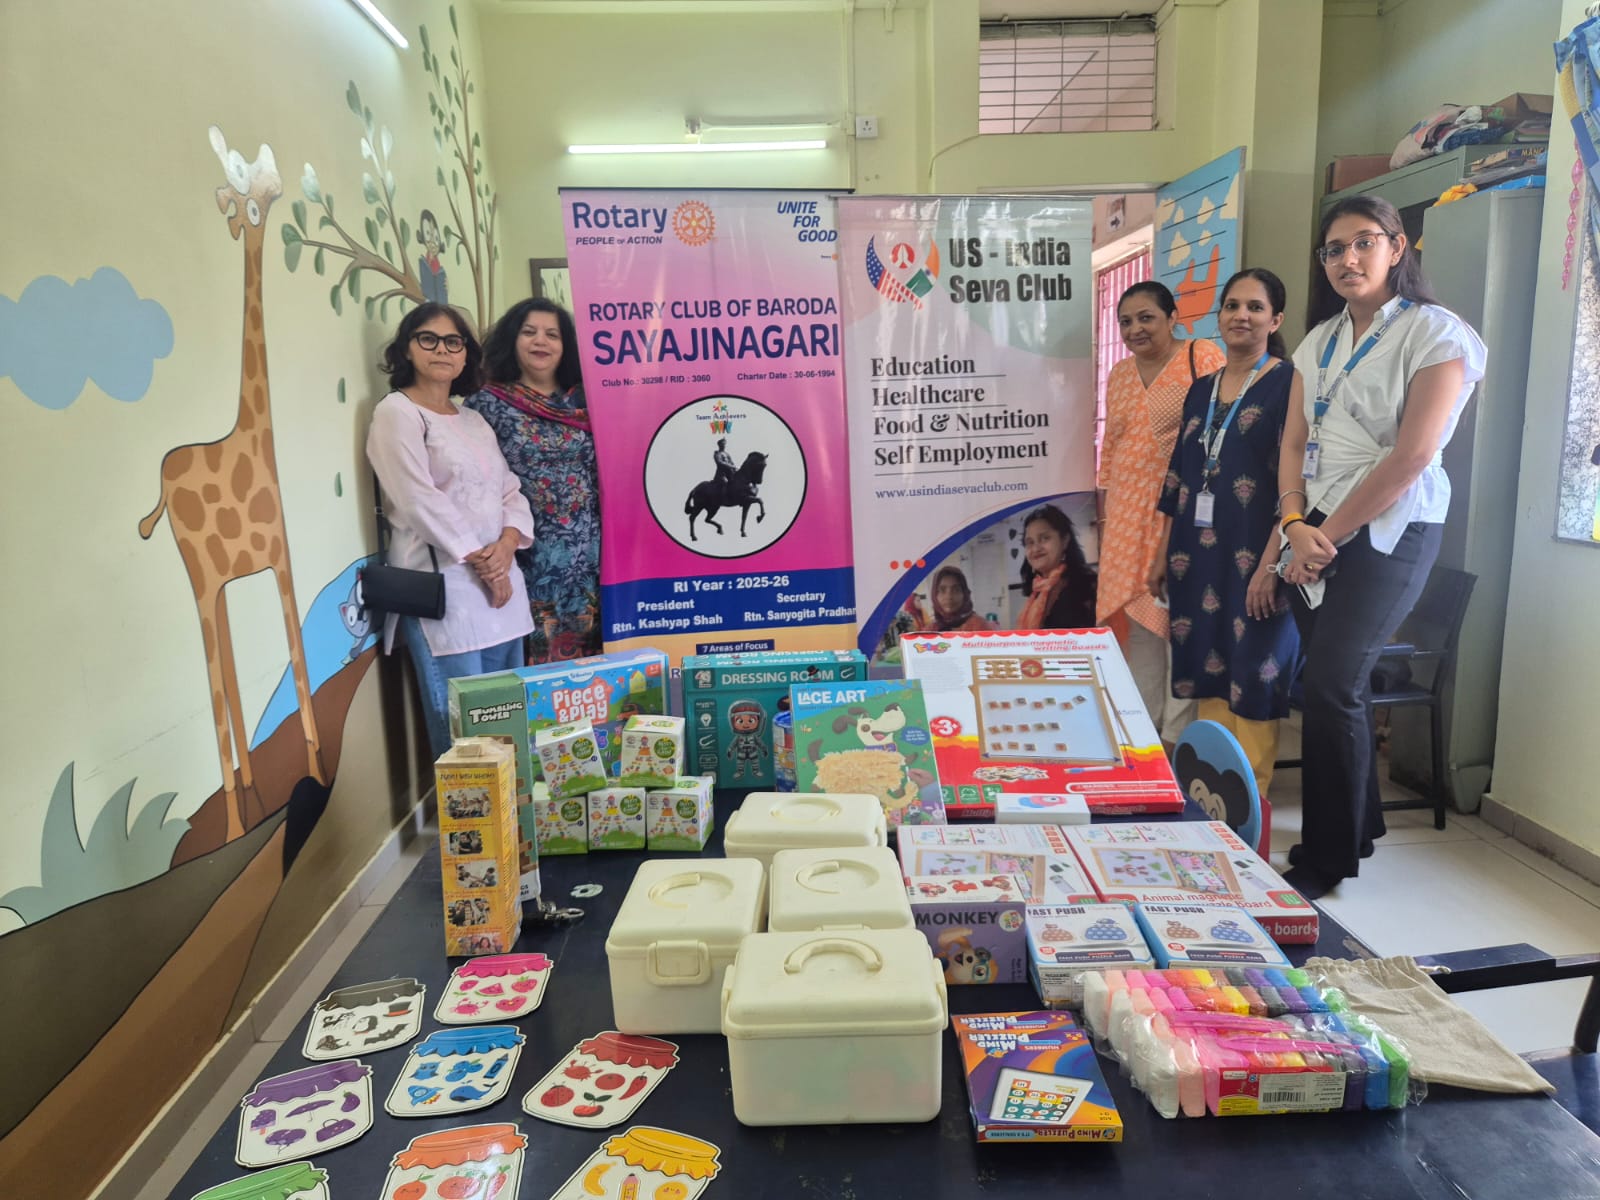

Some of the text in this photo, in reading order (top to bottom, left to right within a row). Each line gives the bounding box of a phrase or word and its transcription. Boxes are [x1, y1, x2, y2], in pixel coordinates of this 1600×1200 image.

[777, 201, 817, 214] UNITE
[572, 201, 668, 233] Rotary
[793, 215, 820, 228] FOR
[575, 237, 615, 245] PEOPLE
[626, 236, 663, 245] ACTION
[798, 229, 838, 242] GOOD
[949, 238, 982, 268] US
[1005, 237, 1071, 267] India
[950, 273, 1072, 304] Seva Club
[589, 297, 838, 321] ROTARY CLUB OF BARODA
[593, 323, 840, 366] SAYAJINAGARI
[871, 355, 975, 377] Education
[601, 379, 622, 387] Club
[670, 376, 685, 384] RID
[737, 372, 767, 381] Charter
[768, 371, 787, 380] Date
[872, 385, 985, 407] Healthcare
[874, 409, 1049, 435] Food & Nutrition
[874, 440, 1048, 466] Self Employment
[875, 480, 1028, 499] www.usindiasevaclub.com
[673, 581, 688, 593] RI
[692, 579, 724, 592] Year
[736, 575, 789, 589] 2025-26
[776, 591, 826, 603] Secretary
[636, 599, 695, 612] President
[744, 611, 765, 622] Rtn.
[767, 608, 816, 622] Sanyogita
[612, 614, 723, 634] Rtn. Kashyap Shah
[709, 644, 733, 653] Areas
[735, 643, 743, 651] of
[745, 642, 768, 651] Focus
[722, 671, 787, 686] DRESSING
[790, 669, 834, 682] ROOM
[553, 684, 606, 710] Piece
[798, 690, 867, 705] LACE ART
[1142, 893, 1244, 904] Animal magnetic
[1235, 900, 1272, 909] board
[1056, 906, 1086, 915] PUSH
[1174, 906, 1205, 914] PUSH
[915, 911, 999, 926] MONKEY
[1275, 922, 1311, 936] board
